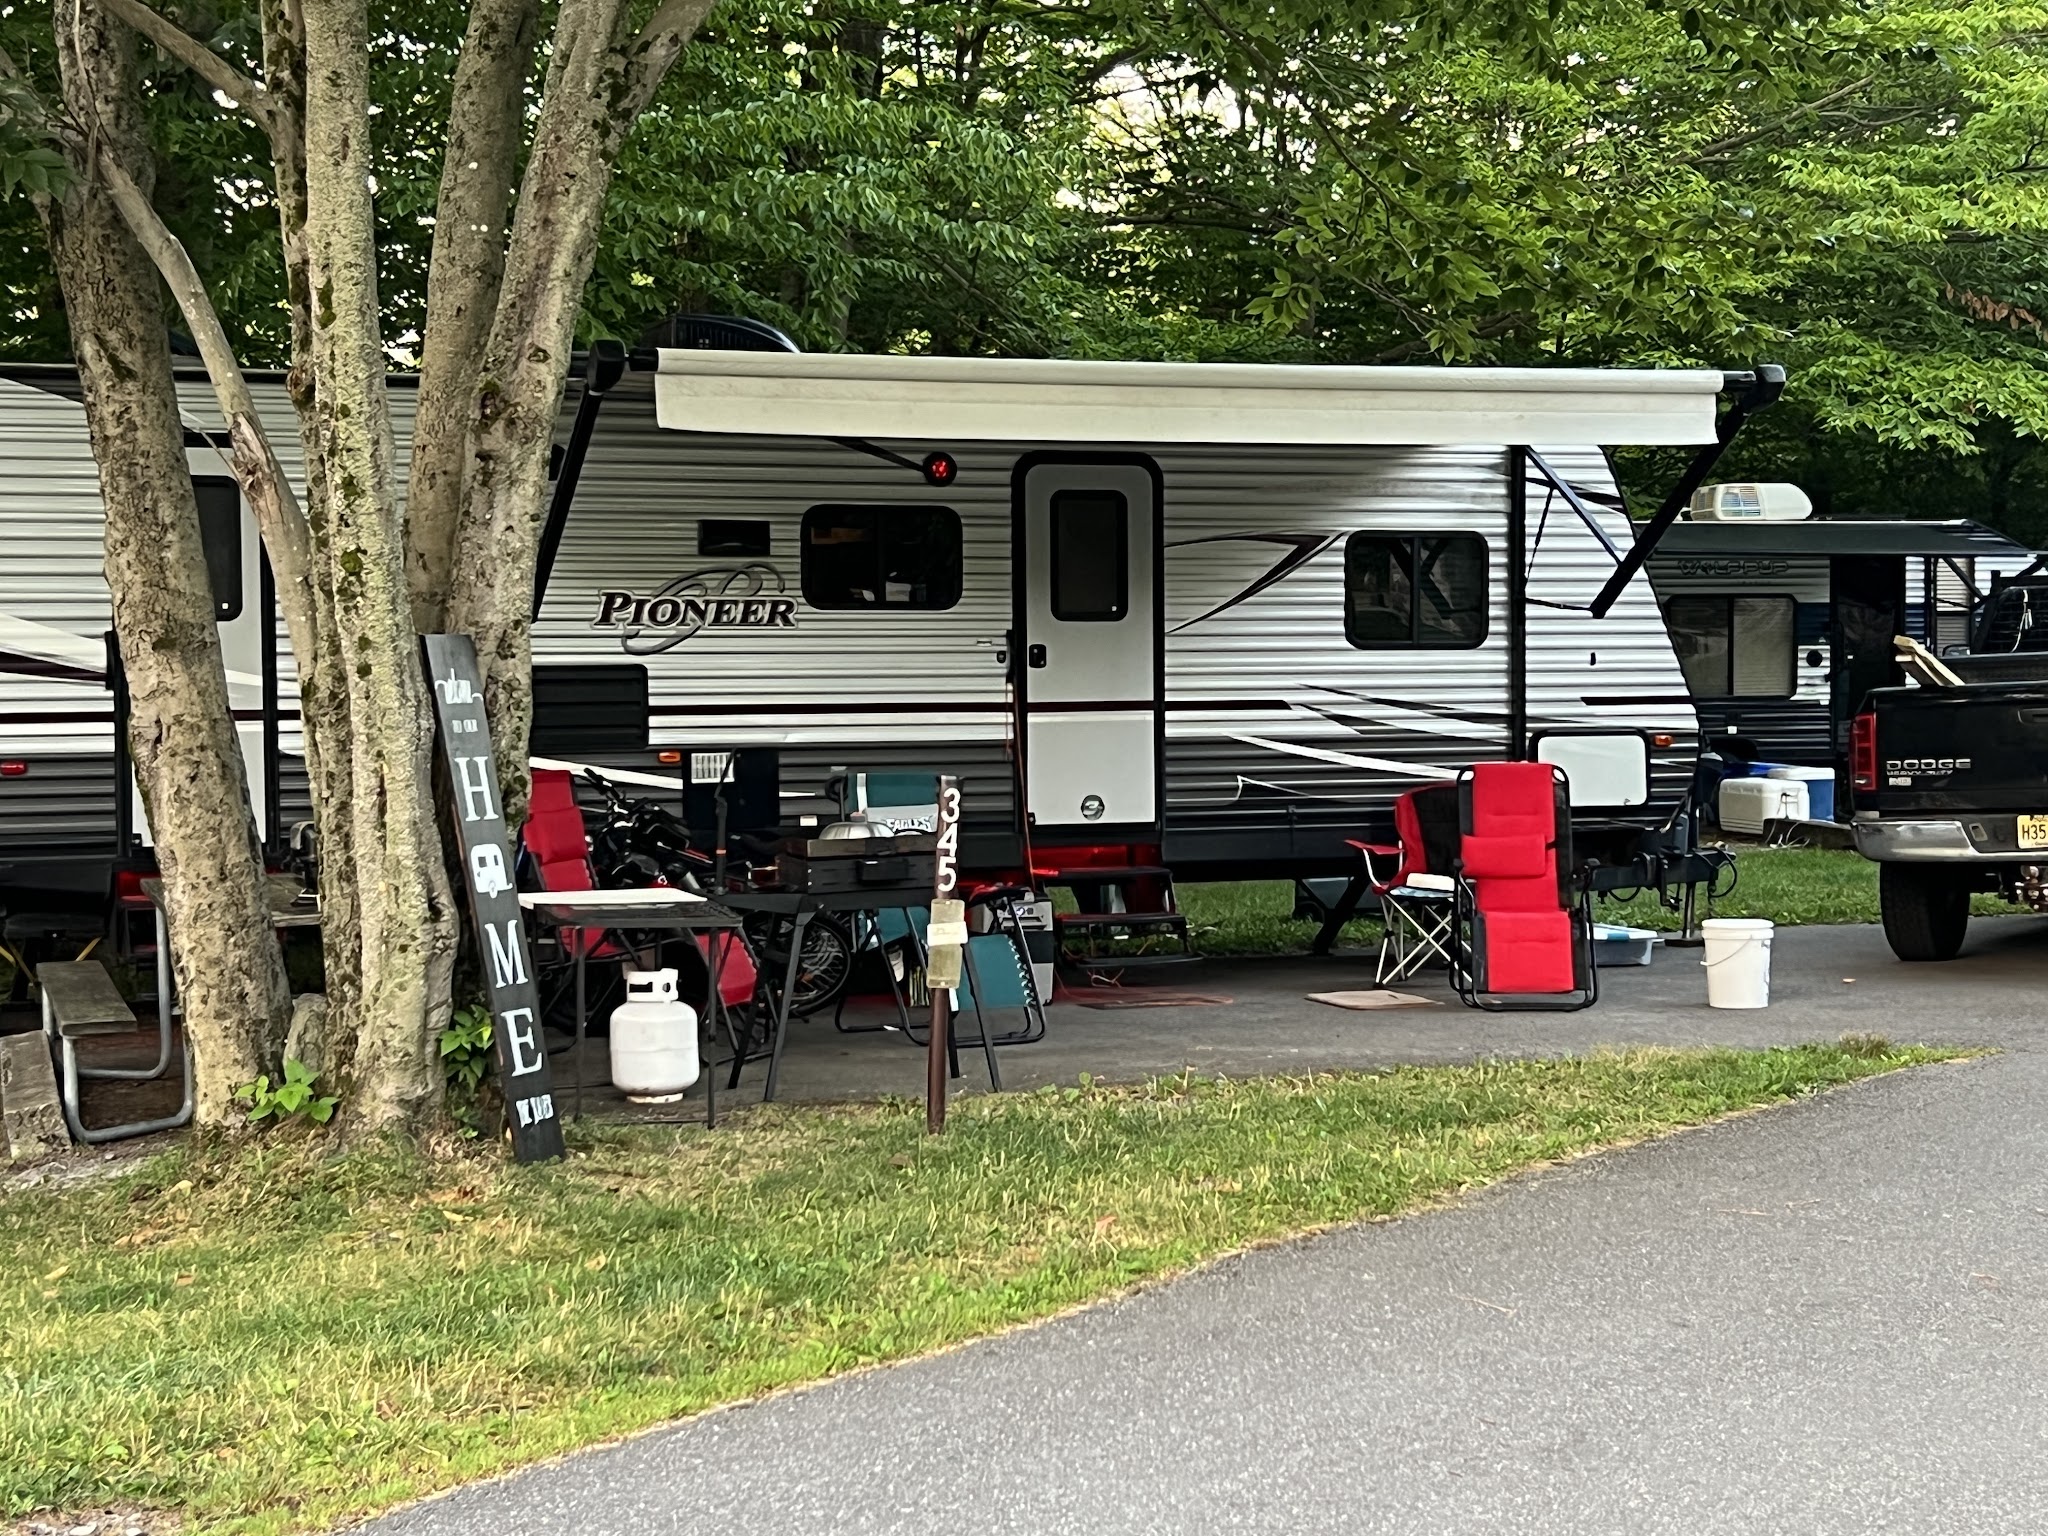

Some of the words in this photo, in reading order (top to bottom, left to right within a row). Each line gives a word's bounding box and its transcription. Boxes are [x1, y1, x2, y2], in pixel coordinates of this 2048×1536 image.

[592, 590, 797, 628] PIONEER
[1886, 758, 1971, 770] DODGE
[937, 787, 961, 892] 345
[2022, 824, 2047, 840] H35
